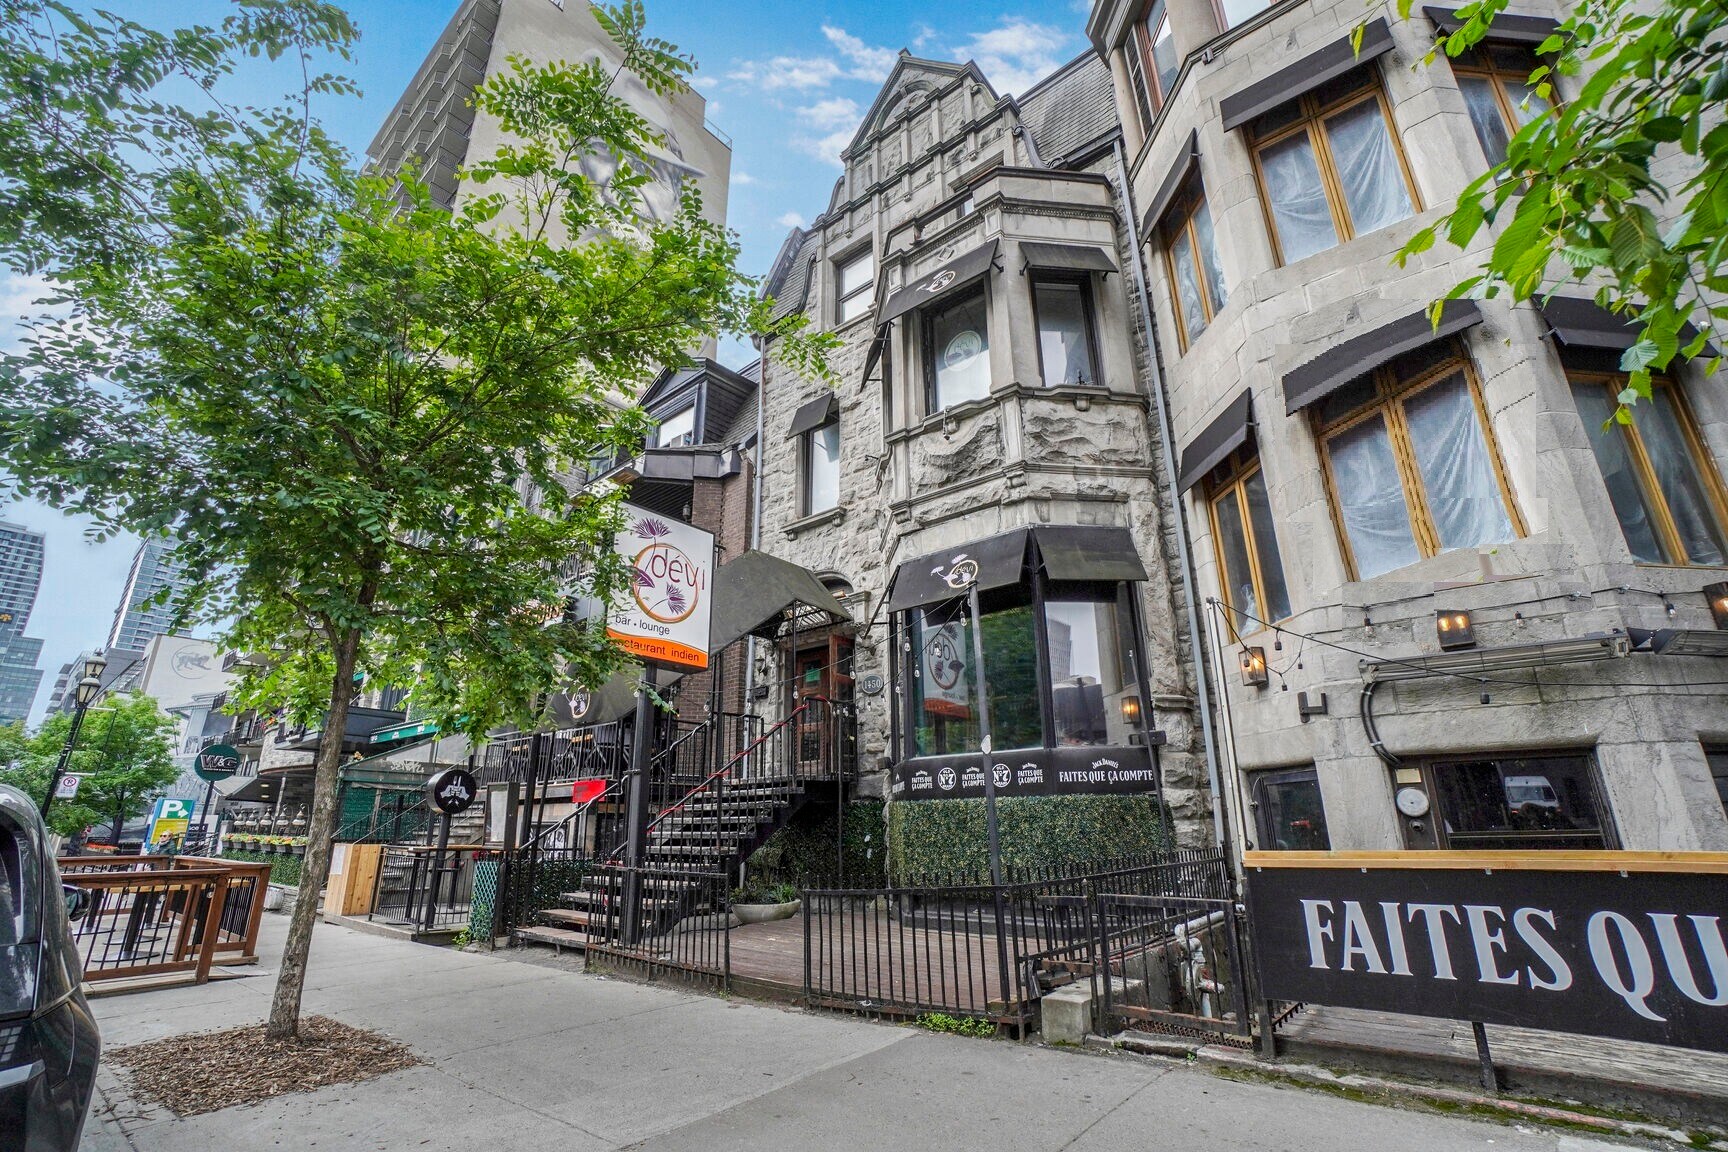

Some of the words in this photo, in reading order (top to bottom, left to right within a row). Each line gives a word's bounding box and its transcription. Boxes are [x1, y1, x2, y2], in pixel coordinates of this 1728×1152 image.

[651, 548, 705, 591] dévi
[615, 613, 632, 626] bar
[639, 619, 671, 636] lounge
[612, 638, 666, 656] staurant
[671, 647, 700, 661] indien
[1059, 771, 1088, 783] FAITES
[1088, 770, 1106, 784] QUE
[1107, 770, 1119, 785] ÇA
[1119, 769, 1154, 782] COMPTE
[160, 799, 183, 818] P
[1300, 899, 1573, 992] FAITES
[1587, 910, 1728, 1022] QU
